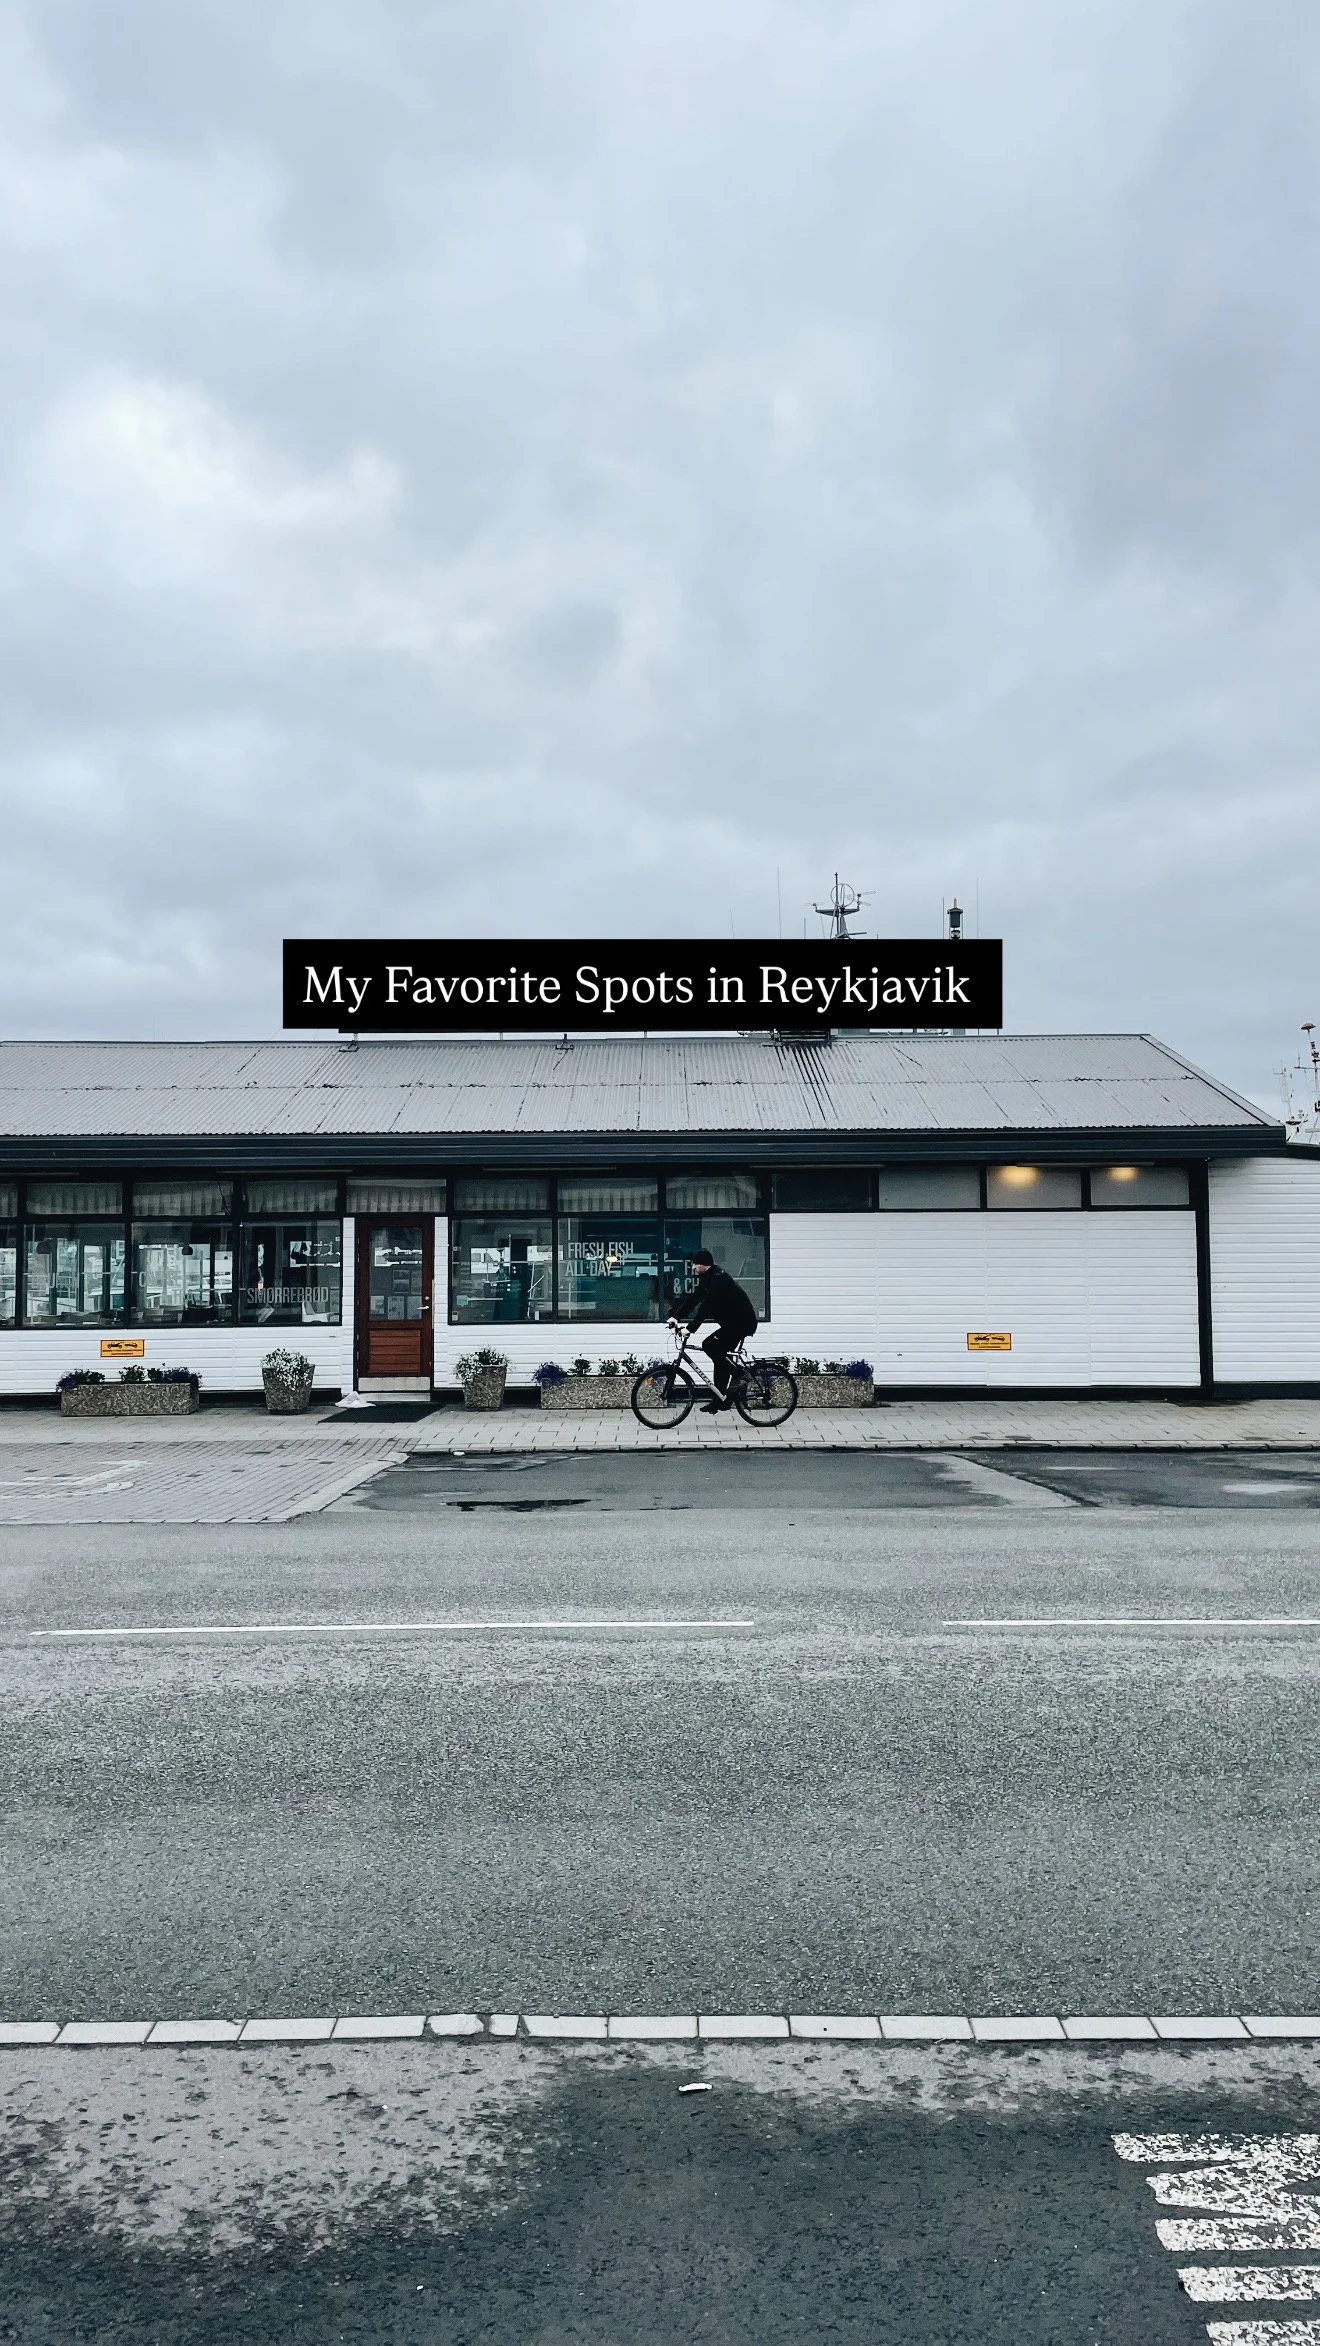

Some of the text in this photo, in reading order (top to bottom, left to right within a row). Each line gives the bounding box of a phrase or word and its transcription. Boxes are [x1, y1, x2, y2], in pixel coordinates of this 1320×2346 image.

[567, 1241, 634, 1259] FRESH FISH
[564, 1260, 612, 1277] ALL DAY
[247, 1286, 329, 1304] SMØRREBRØD
